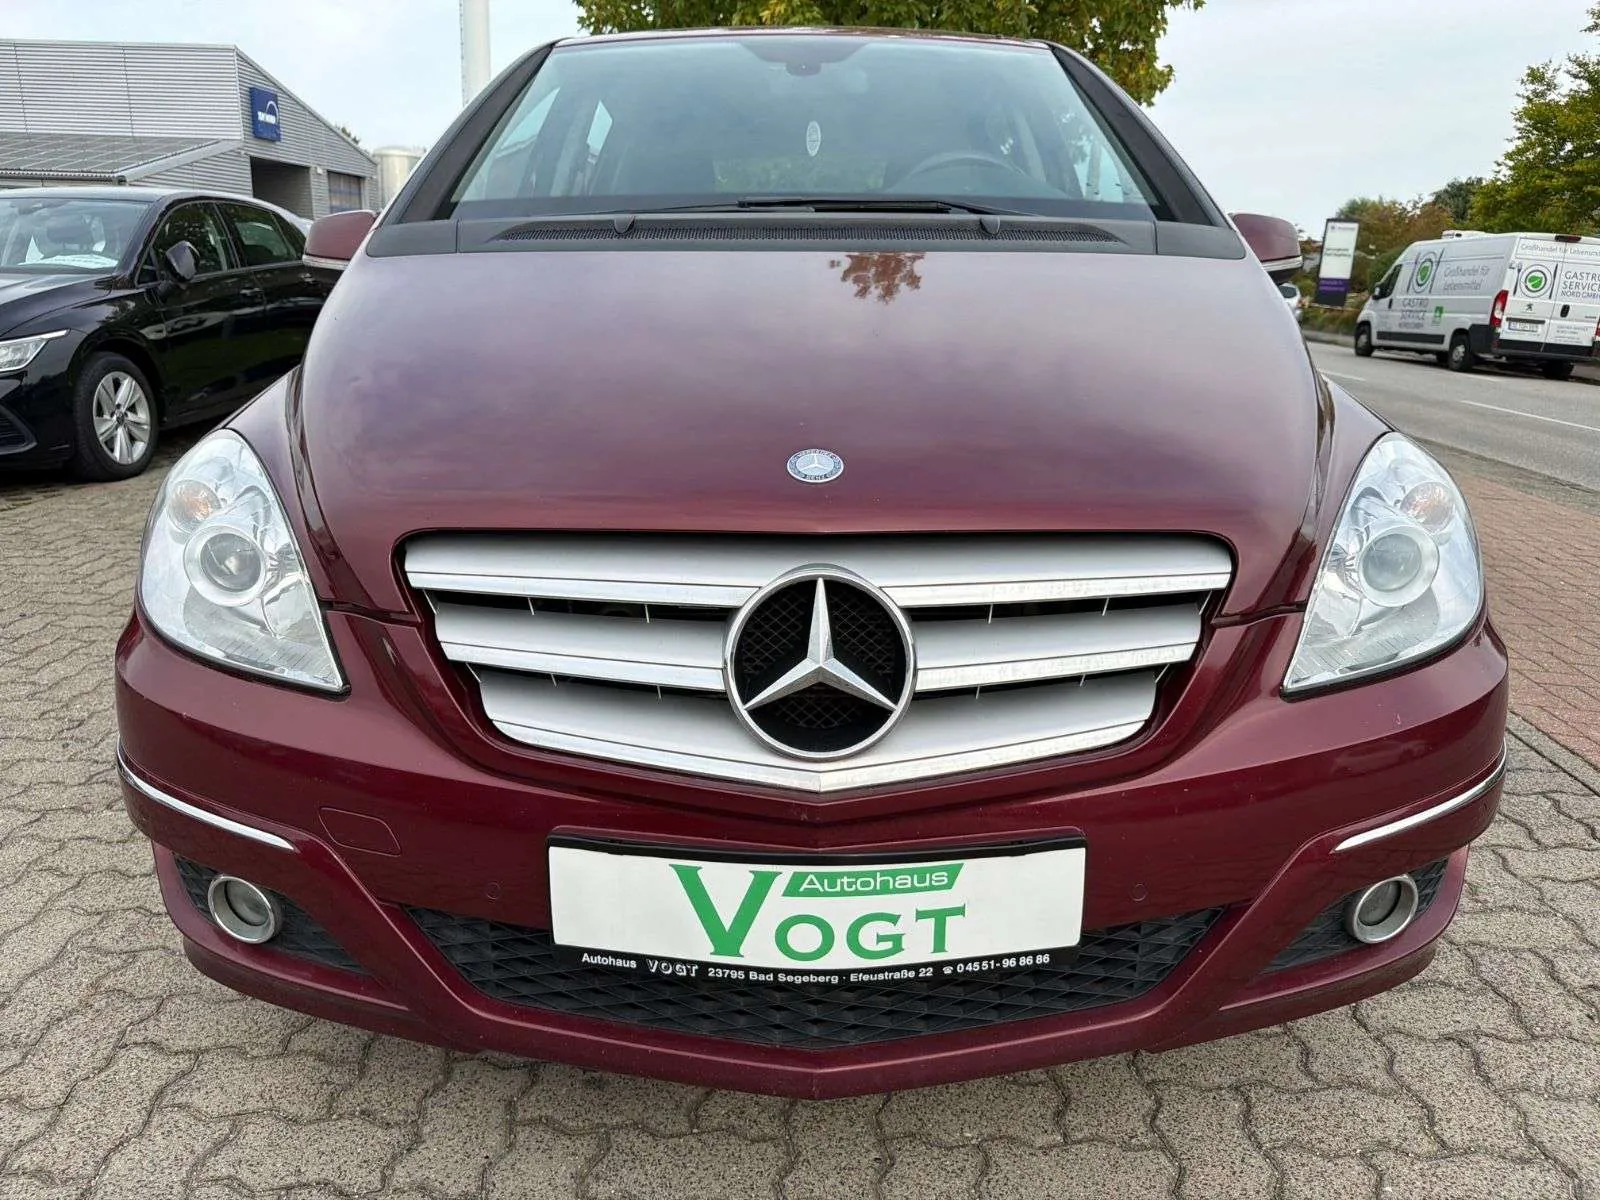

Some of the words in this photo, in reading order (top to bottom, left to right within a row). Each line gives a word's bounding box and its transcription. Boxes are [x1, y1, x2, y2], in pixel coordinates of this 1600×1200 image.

[799, 869, 949, 893] Autohaus
[668, 863, 967, 962] VOGT
[581, 952, 638, 969] Autohaus
[645, 958, 700, 978] VOGT
[707, 967, 745, 980] 23795
[749, 970, 774, 982] Bad
[777, 973, 839, 984] Segeberg
[849, 968, 916, 983] Efeustraße
[918, 967, 933, 978] 22
[1019, 955, 1034, 967] 86
[1035, 953, 1050, 965] 86
